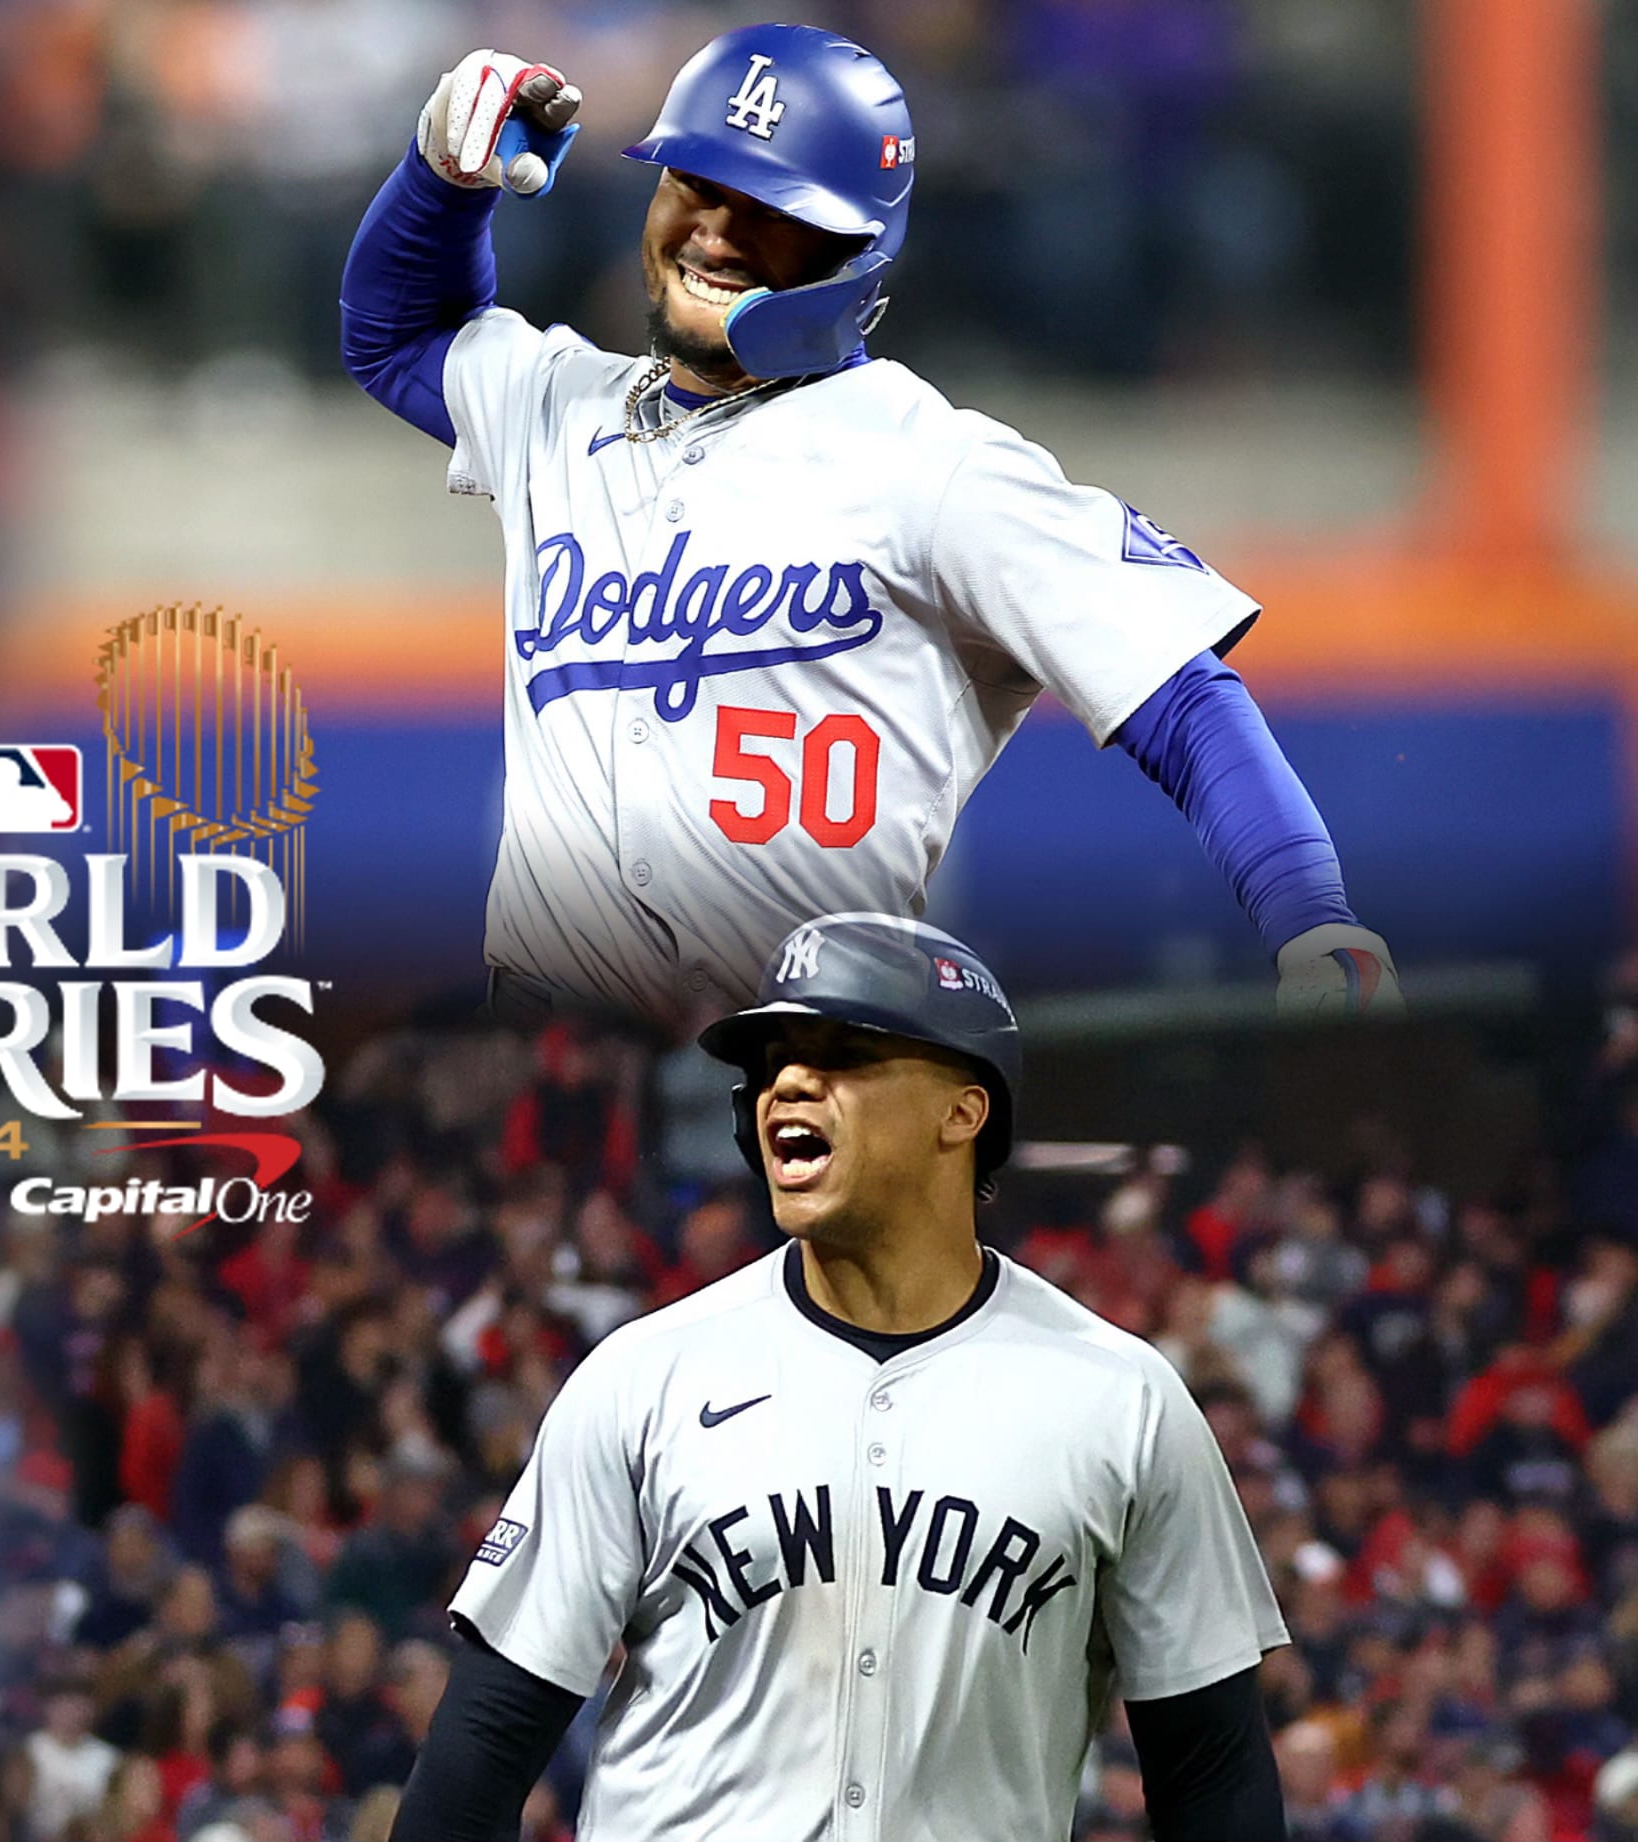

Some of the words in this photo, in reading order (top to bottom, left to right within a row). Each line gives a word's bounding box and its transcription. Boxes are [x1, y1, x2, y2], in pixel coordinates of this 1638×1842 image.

[725, 54, 785, 140] LA
[514, 530, 882, 722] Dodgers
[709, 704, 880, 848] 50
[776, 929, 825, 983] NY
[671, 1484, 835, 1644] NEW
[876, 1486, 1078, 1656] YORK
